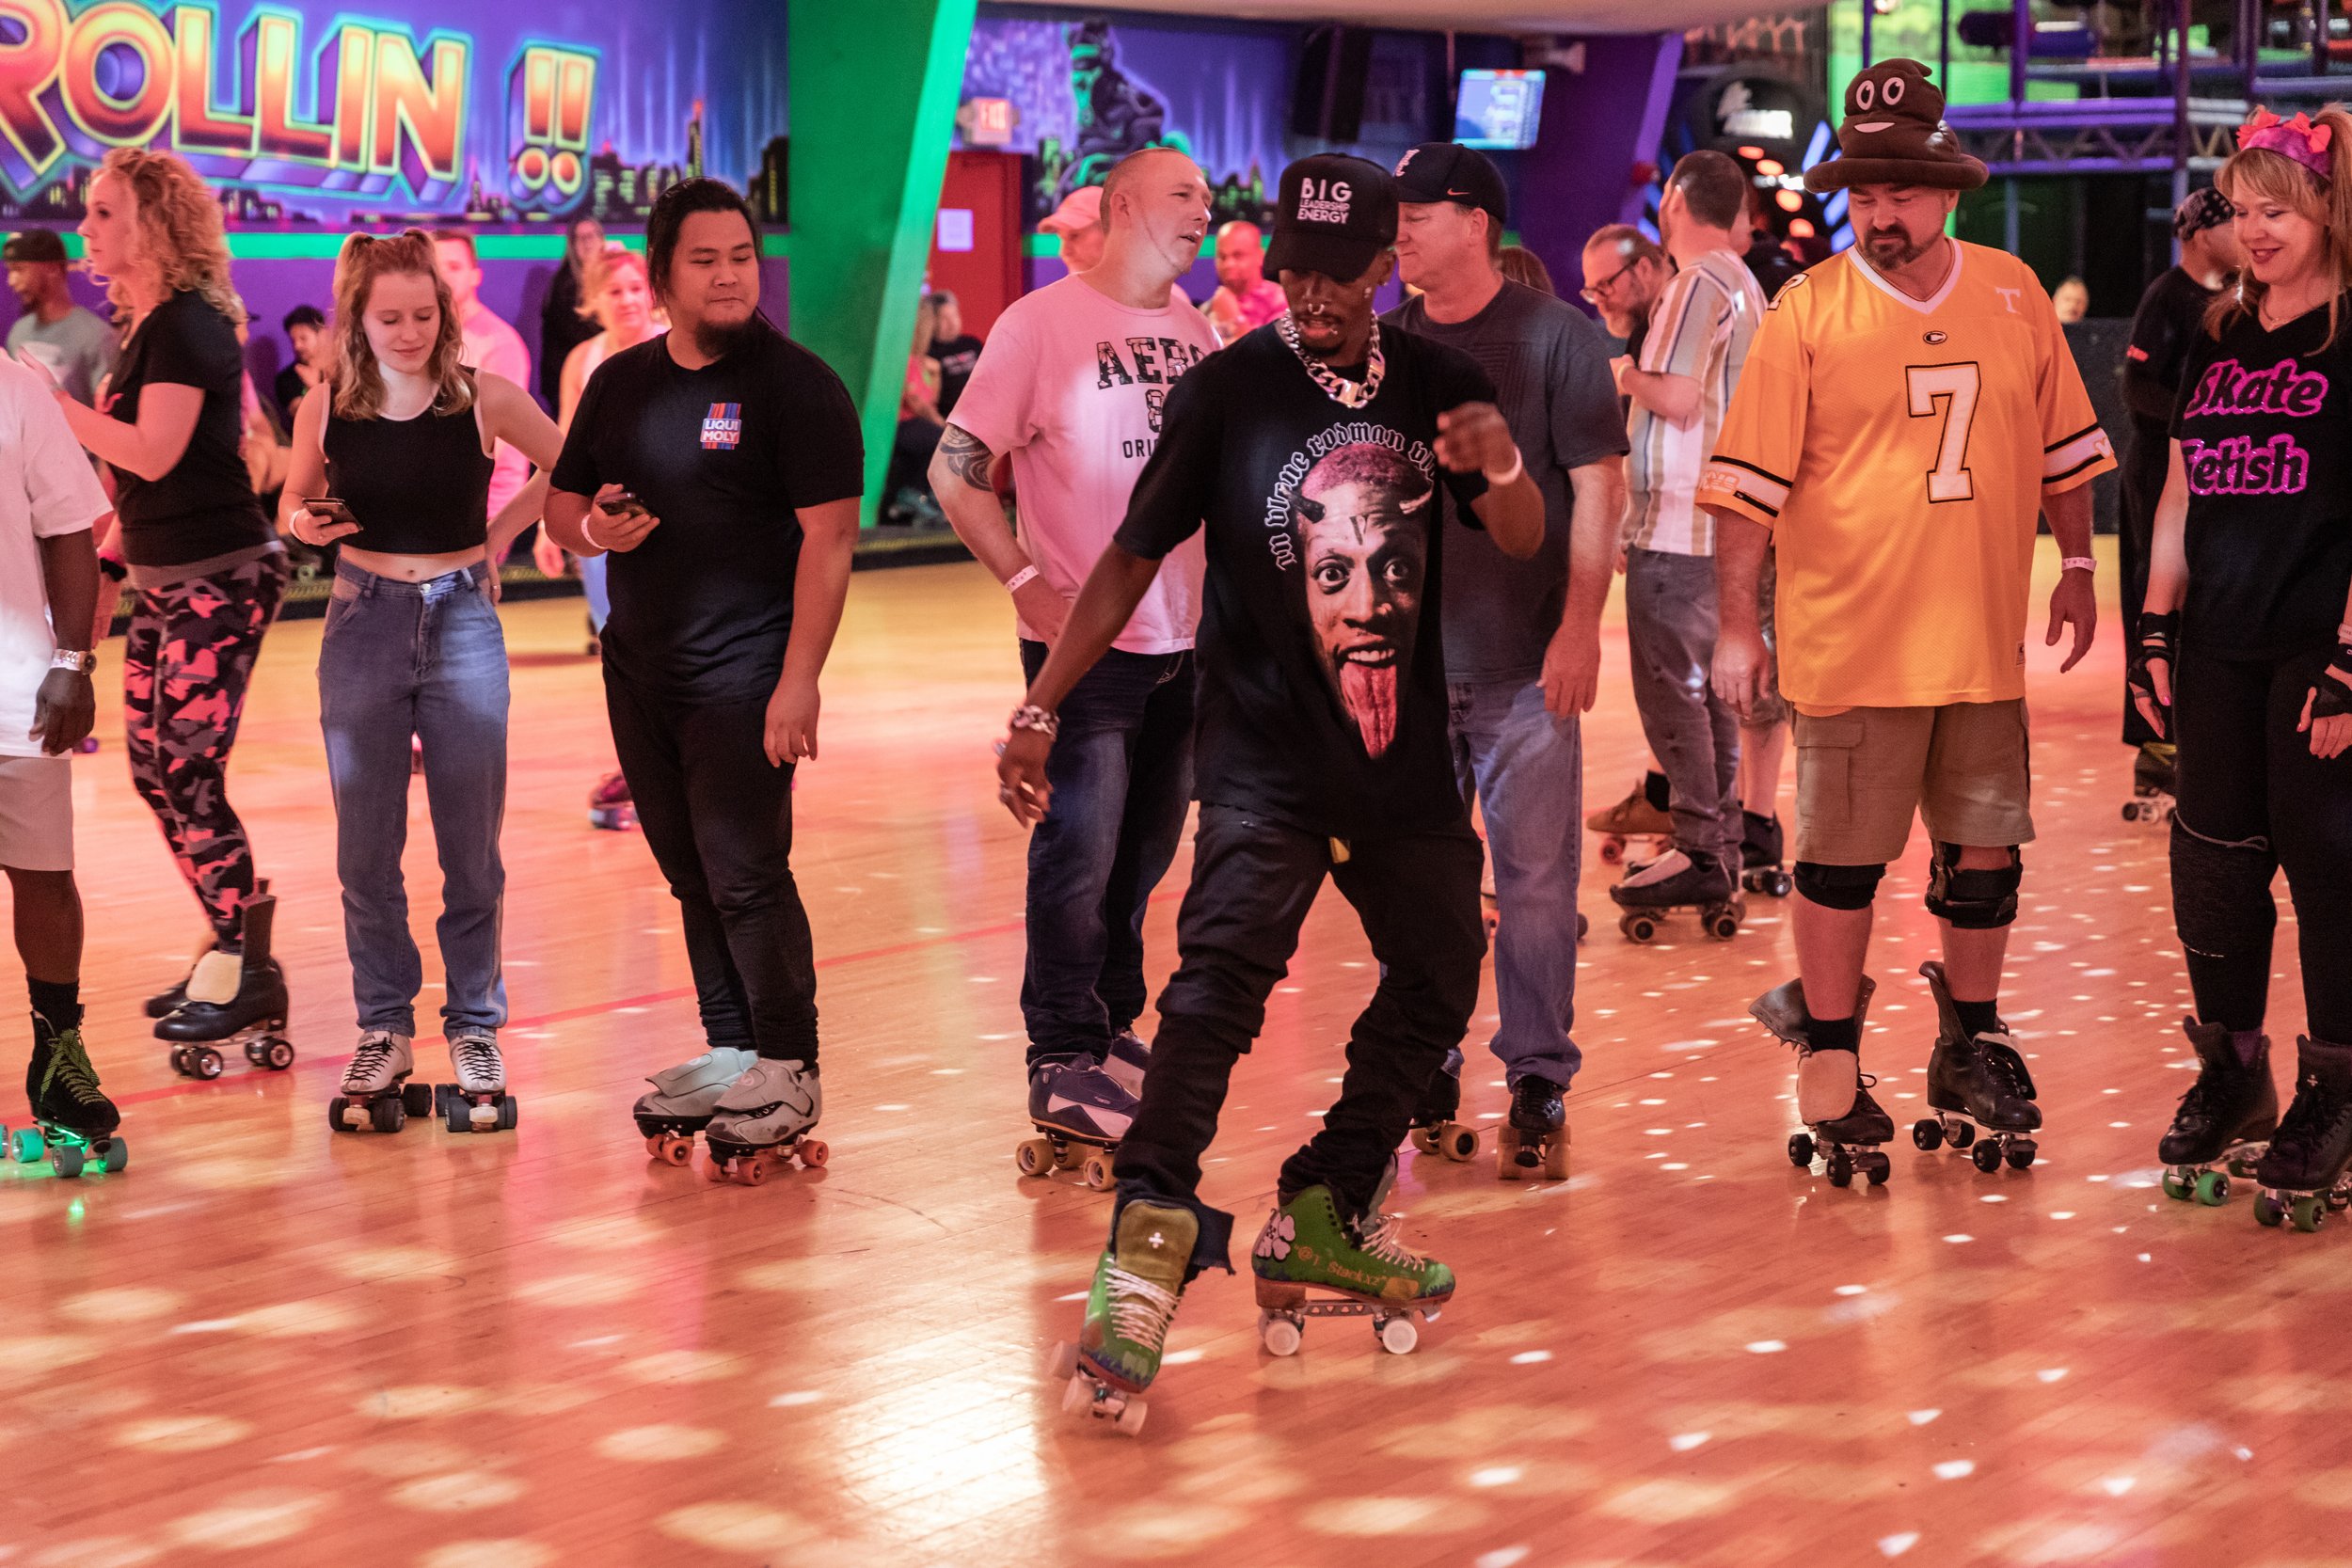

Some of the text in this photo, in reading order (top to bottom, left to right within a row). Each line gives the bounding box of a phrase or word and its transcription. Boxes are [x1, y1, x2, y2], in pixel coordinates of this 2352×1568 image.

[1300, 176, 1353, 203] BIG
[1299, 198, 1351, 213] LEADERSHIP
[1297, 208, 1350, 225] ENERGY
[2184, 357, 2329, 420] Skate
[705, 420, 739, 431] LIQUI
[1905, 360, 1982, 504] 7
[702, 430, 739, 442] MOLY
